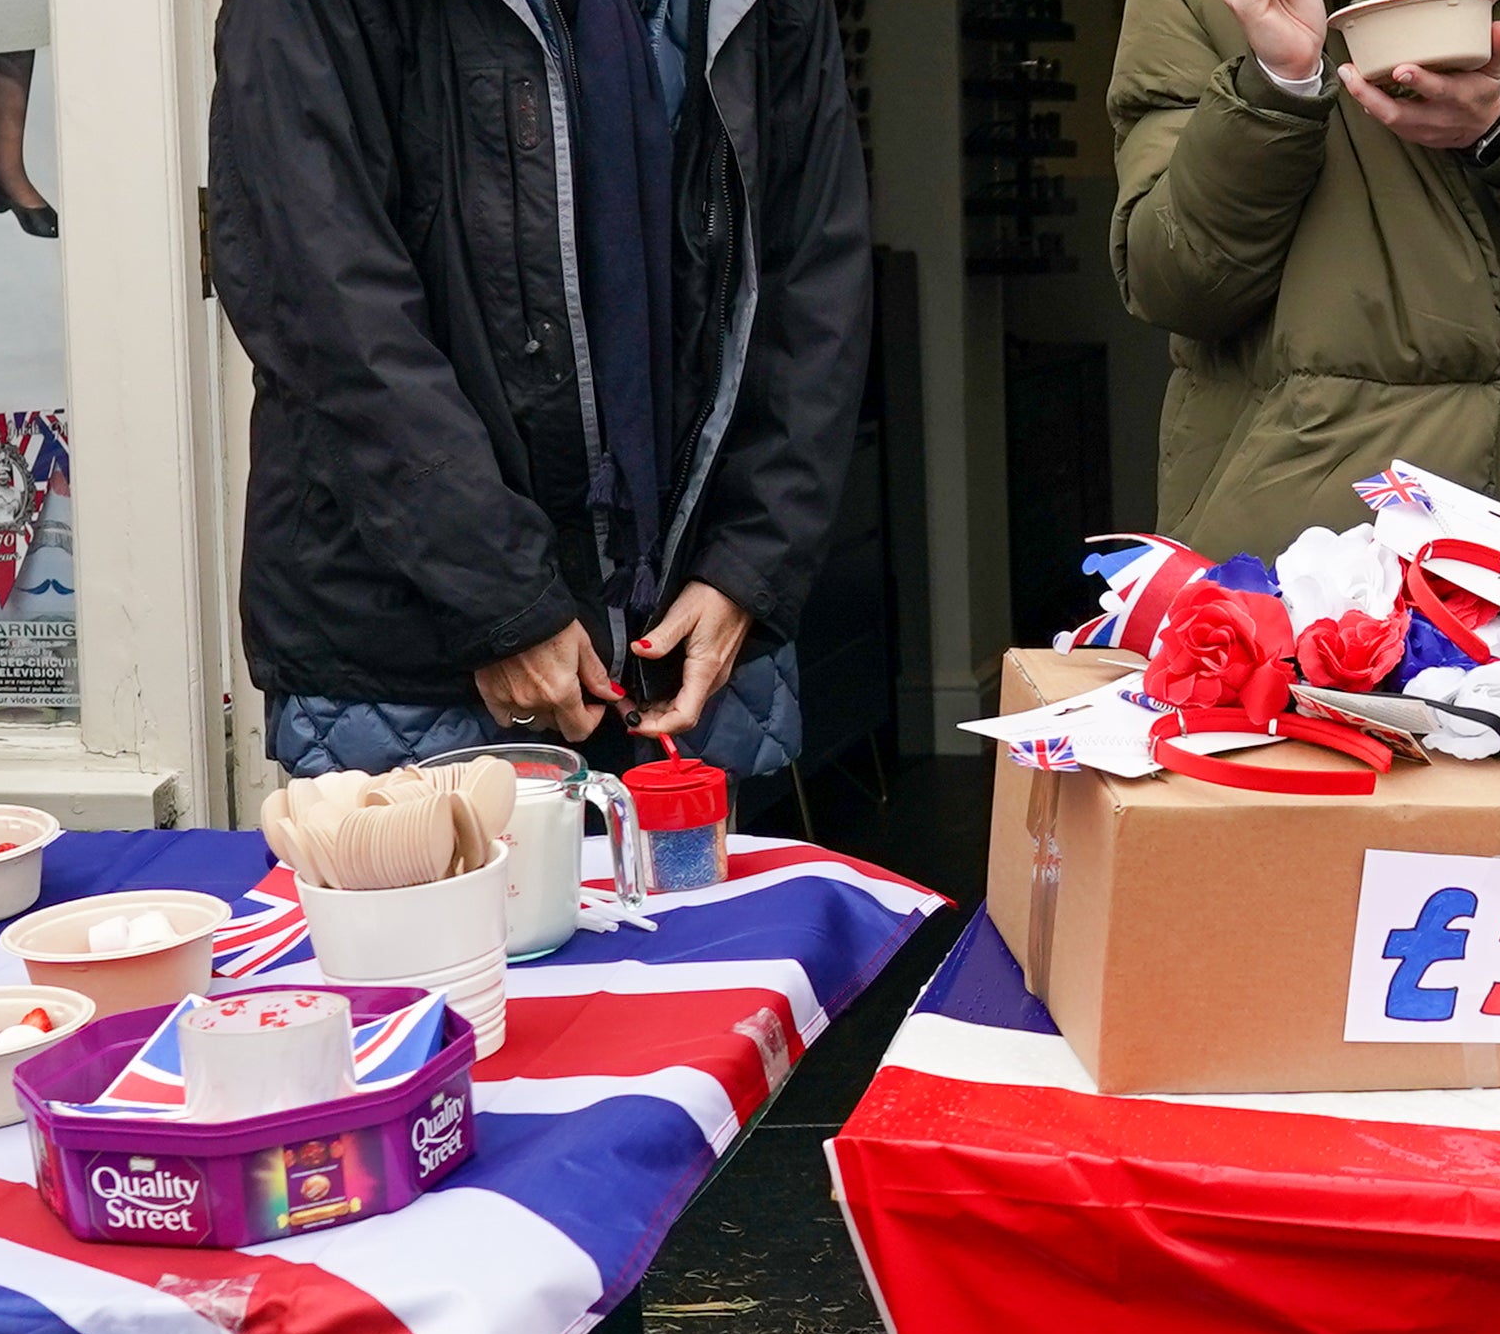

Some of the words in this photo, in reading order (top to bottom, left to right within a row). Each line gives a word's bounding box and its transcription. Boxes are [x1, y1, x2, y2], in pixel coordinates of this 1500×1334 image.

[11, 695, 37, 704] video
[411, 1094, 466, 1152] Quality
[418, 1128, 465, 1179] Street
[91, 1166, 200, 1211] Quality
[105, 1198, 195, 1232] Street
